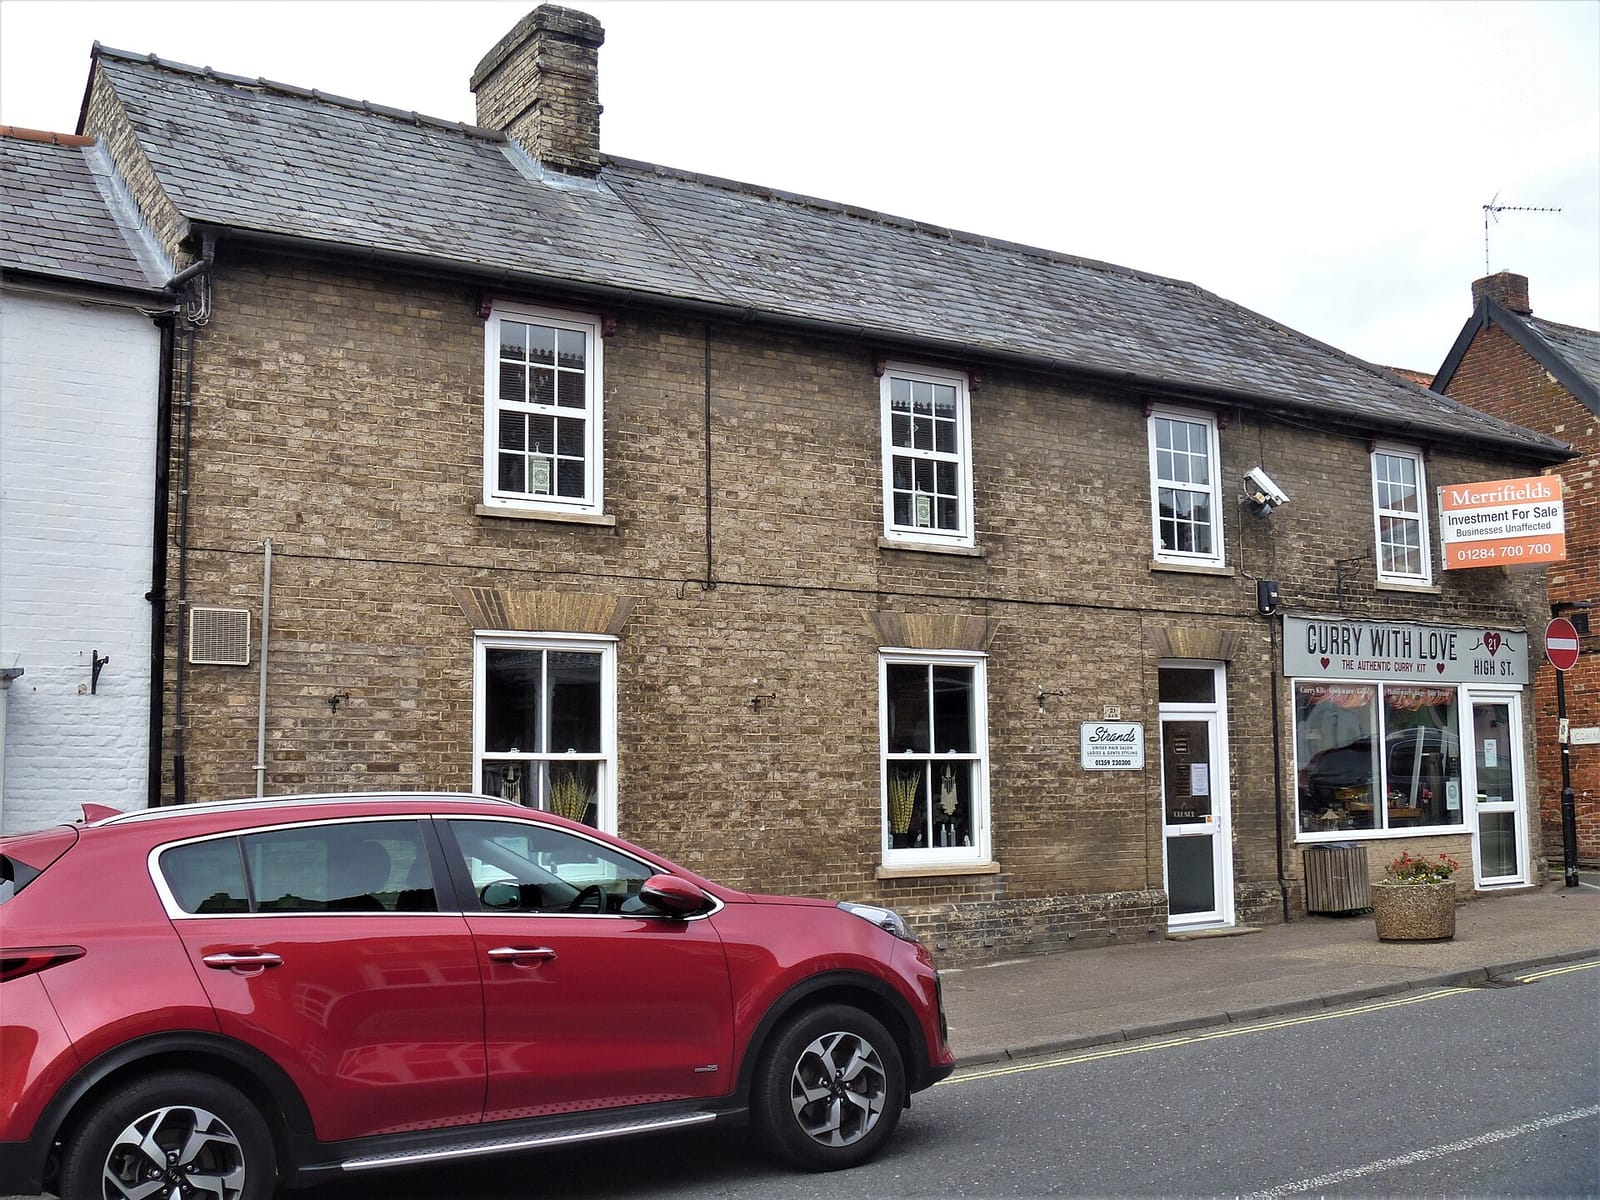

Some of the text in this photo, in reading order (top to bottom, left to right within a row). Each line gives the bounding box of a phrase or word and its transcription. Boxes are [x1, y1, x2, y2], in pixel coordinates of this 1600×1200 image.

[1452, 482, 1551, 506] Merrifields
[1448, 506, 1558, 526] Investment For Sale
[1456, 521, 1551, 538] Businesses Unaffected
[1457, 543, 1551, 561] 01284 700 700
[1307, 621, 1458, 661] CURRY WITH LOVE
[1488, 638, 1497, 651] 21
[1342, 659, 1426, 673] THE AUTHENTIC CURRY KIT
[1474, 658, 1514, 676] HIGH ST.
[1089, 726, 1136, 742] Strands
